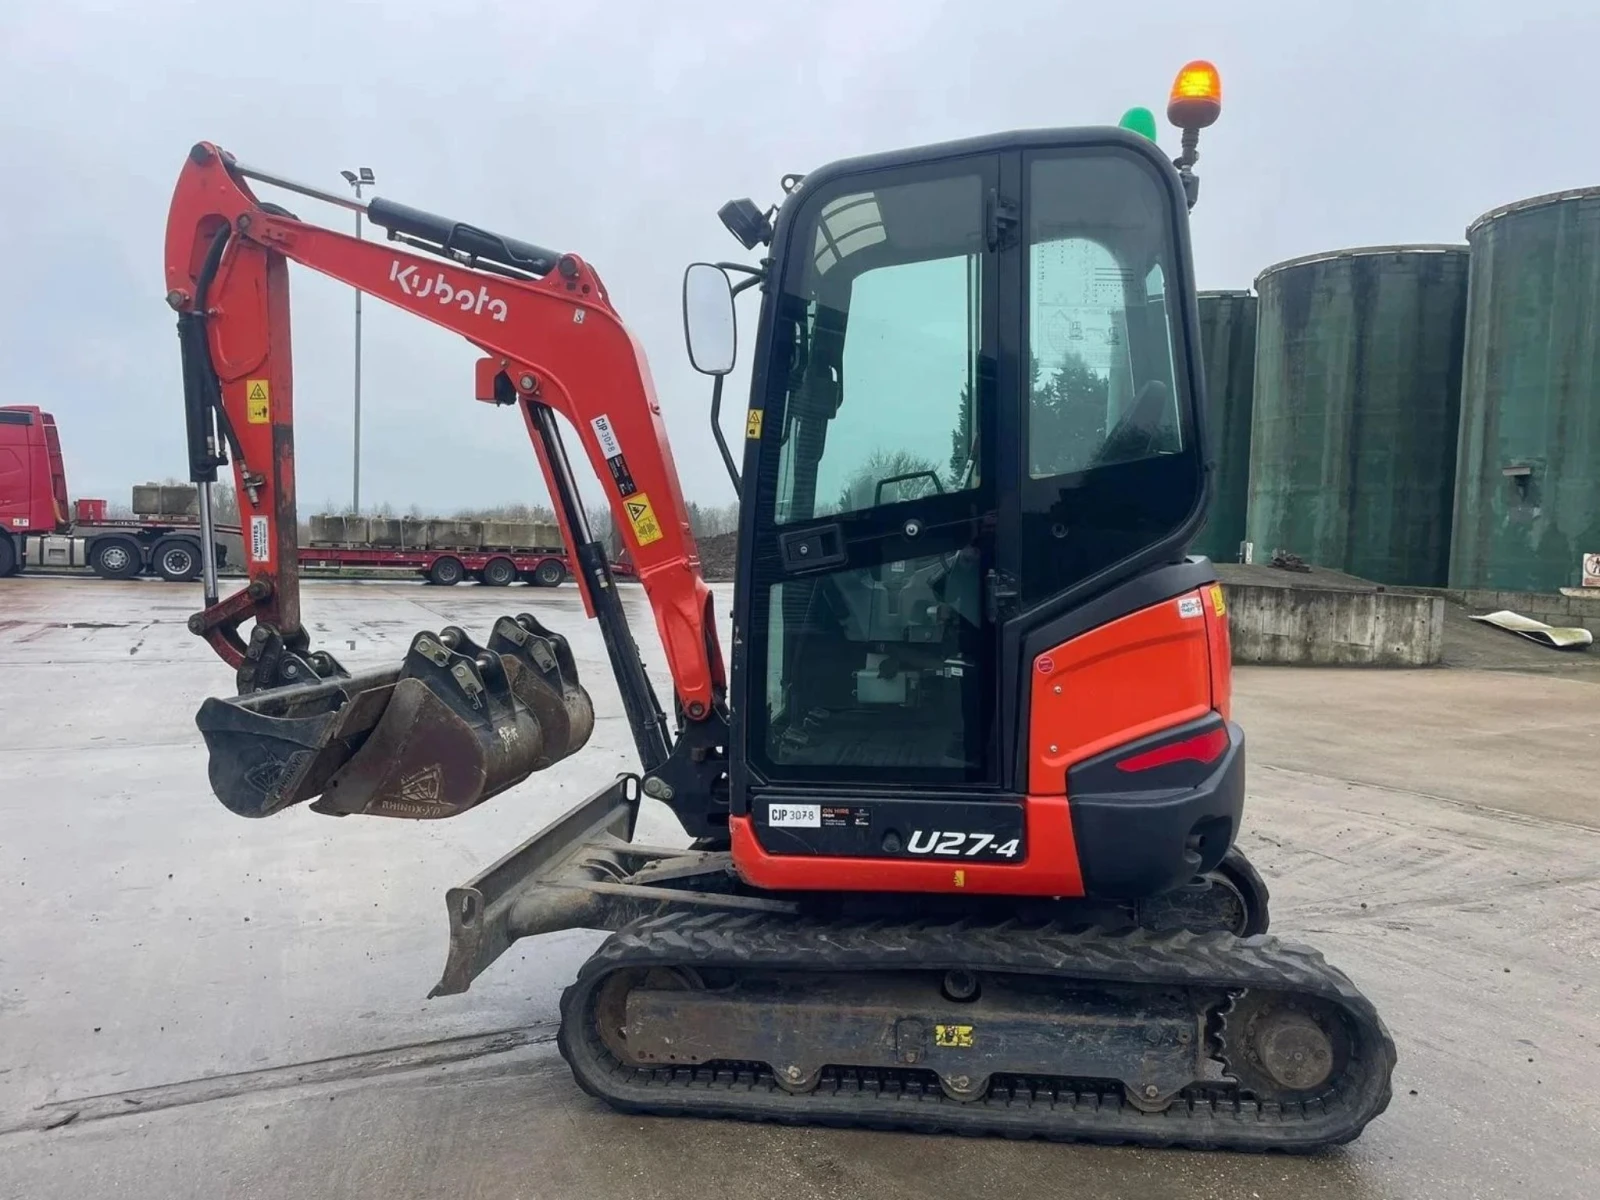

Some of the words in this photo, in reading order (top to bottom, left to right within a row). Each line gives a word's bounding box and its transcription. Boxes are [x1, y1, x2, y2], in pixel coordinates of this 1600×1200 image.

[389, 260, 508, 322] Kubota
[595, 417, 608, 432] CJP
[601, 431, 616, 453] 3078
[771, 809, 788, 821] CJP
[789, 810, 815, 821] 3078
[906, 830, 1021, 858] U27-4
